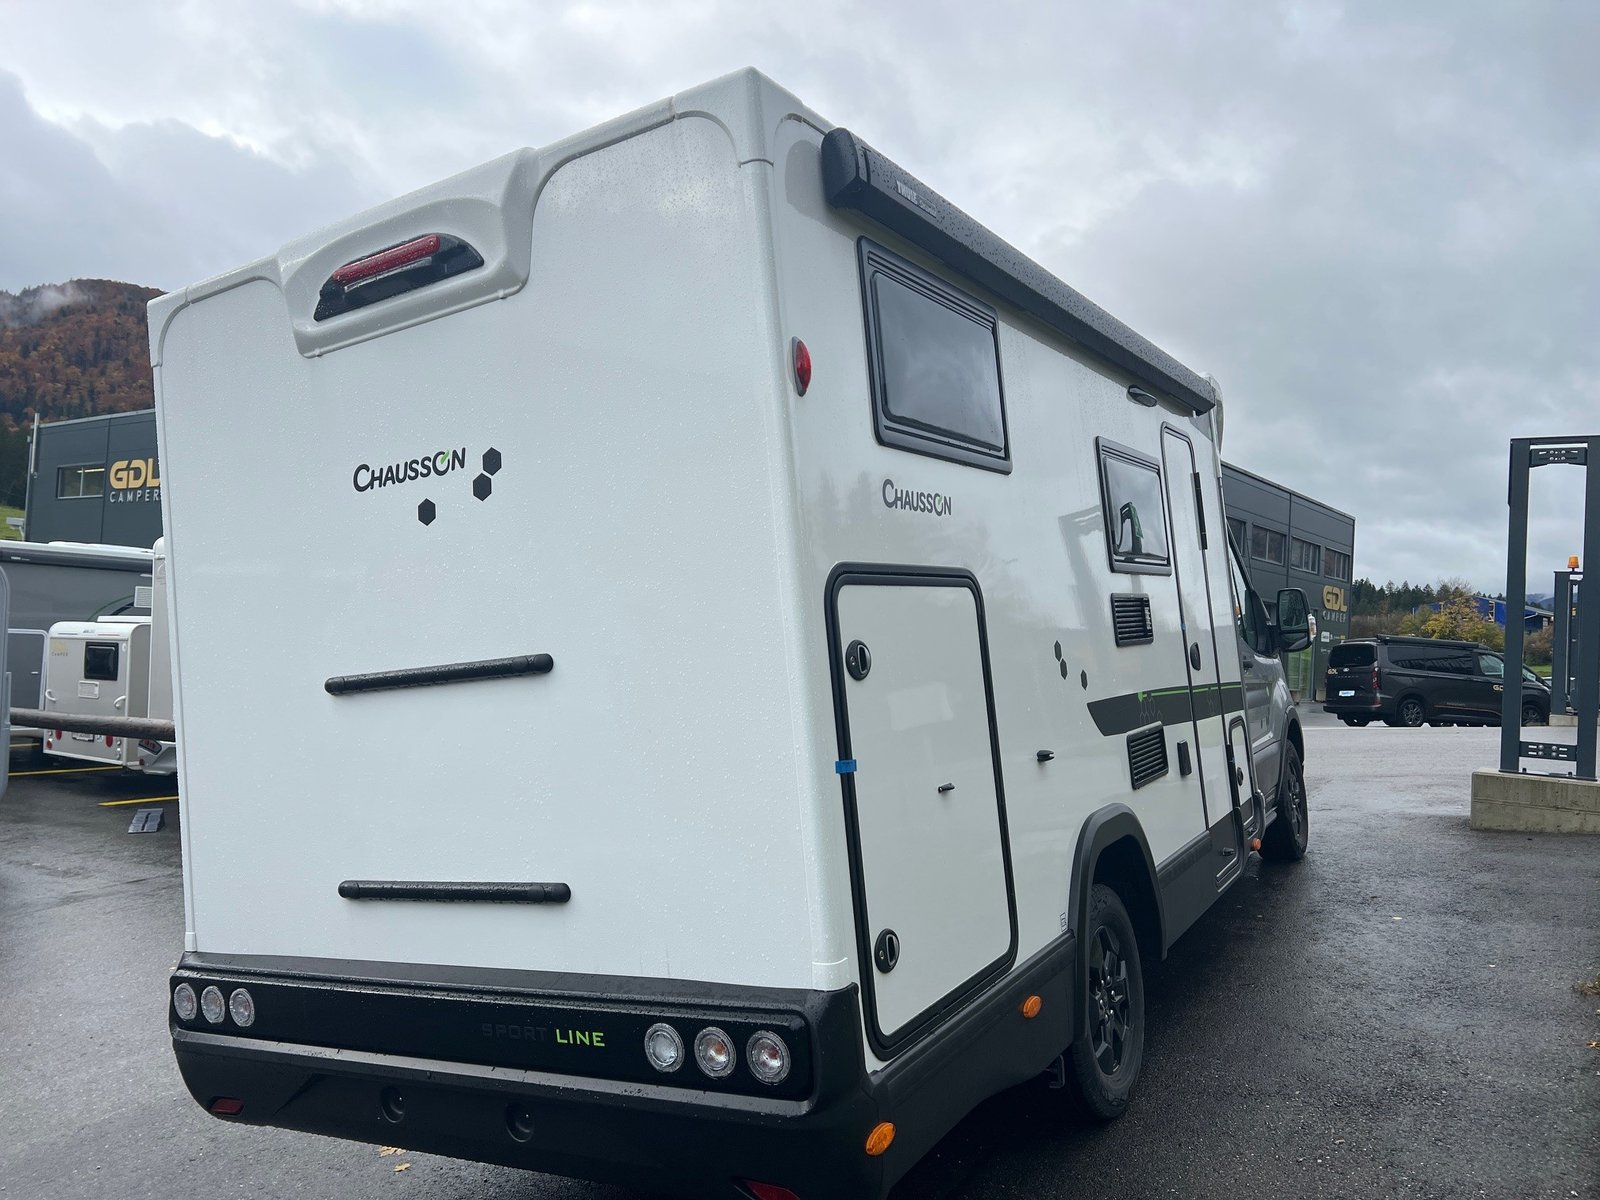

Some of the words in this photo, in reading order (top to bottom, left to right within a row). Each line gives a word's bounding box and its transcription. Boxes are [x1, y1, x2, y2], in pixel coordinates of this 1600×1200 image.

[110, 458, 160, 489] GDL
[353, 447, 466, 492] CHAUSSON
[882, 478, 952, 517] CHAUSSON
[1323, 585, 1348, 612] GDL
[482, 1023, 547, 1041] SPORT
[556, 1028, 605, 1047] LINE
